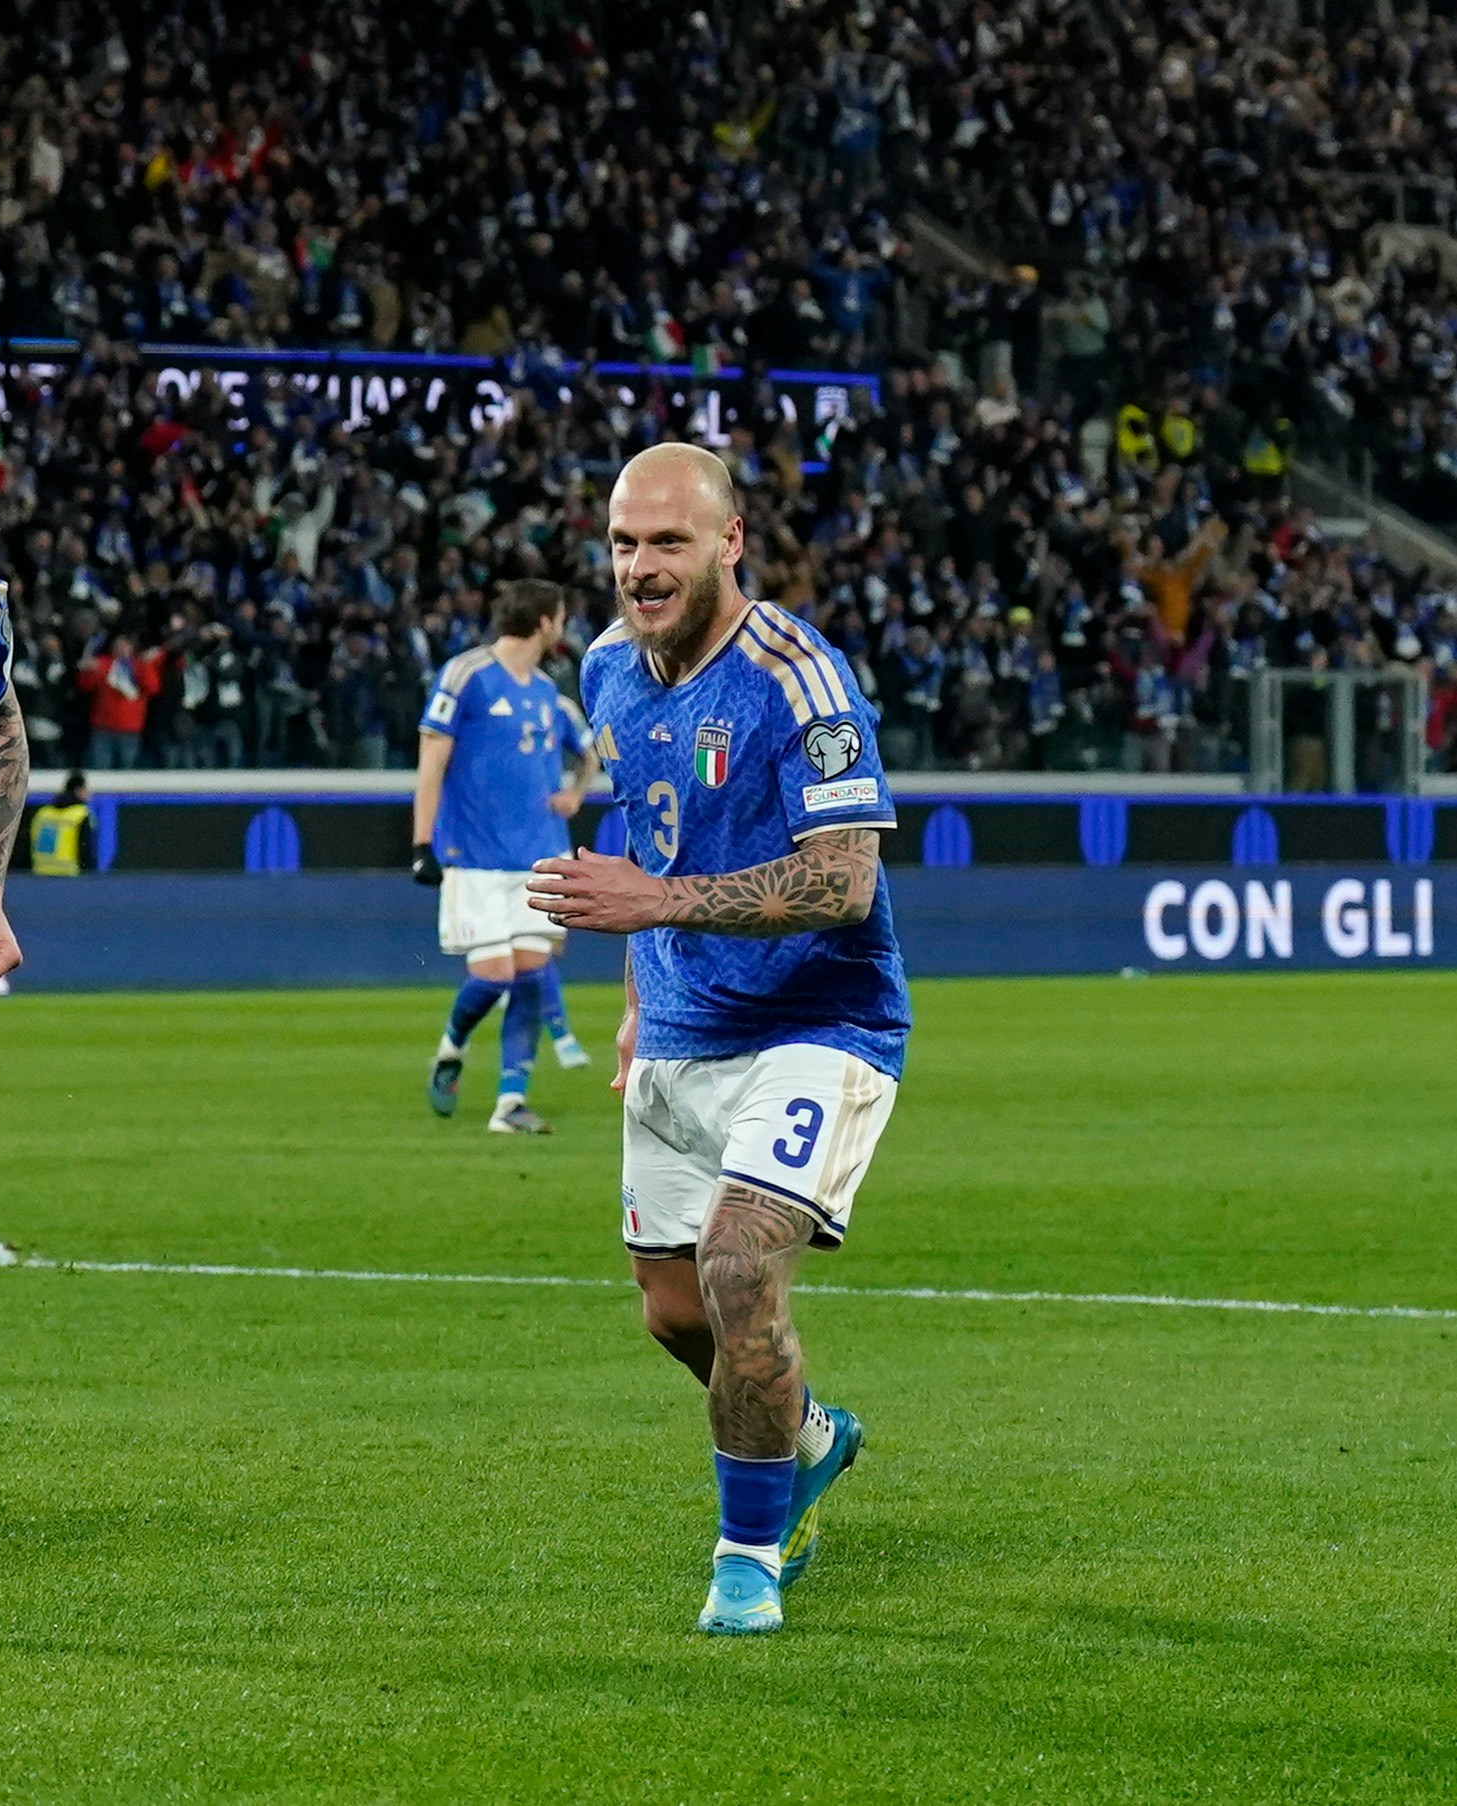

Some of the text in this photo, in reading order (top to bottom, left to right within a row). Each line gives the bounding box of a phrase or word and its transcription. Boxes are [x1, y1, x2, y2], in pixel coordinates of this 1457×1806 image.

[698, 731, 728, 747] ITALIA
[647, 780, 679, 860] 3
[1144, 878, 1434, 960] CON GLI
[772, 1097, 824, 1169] 3
